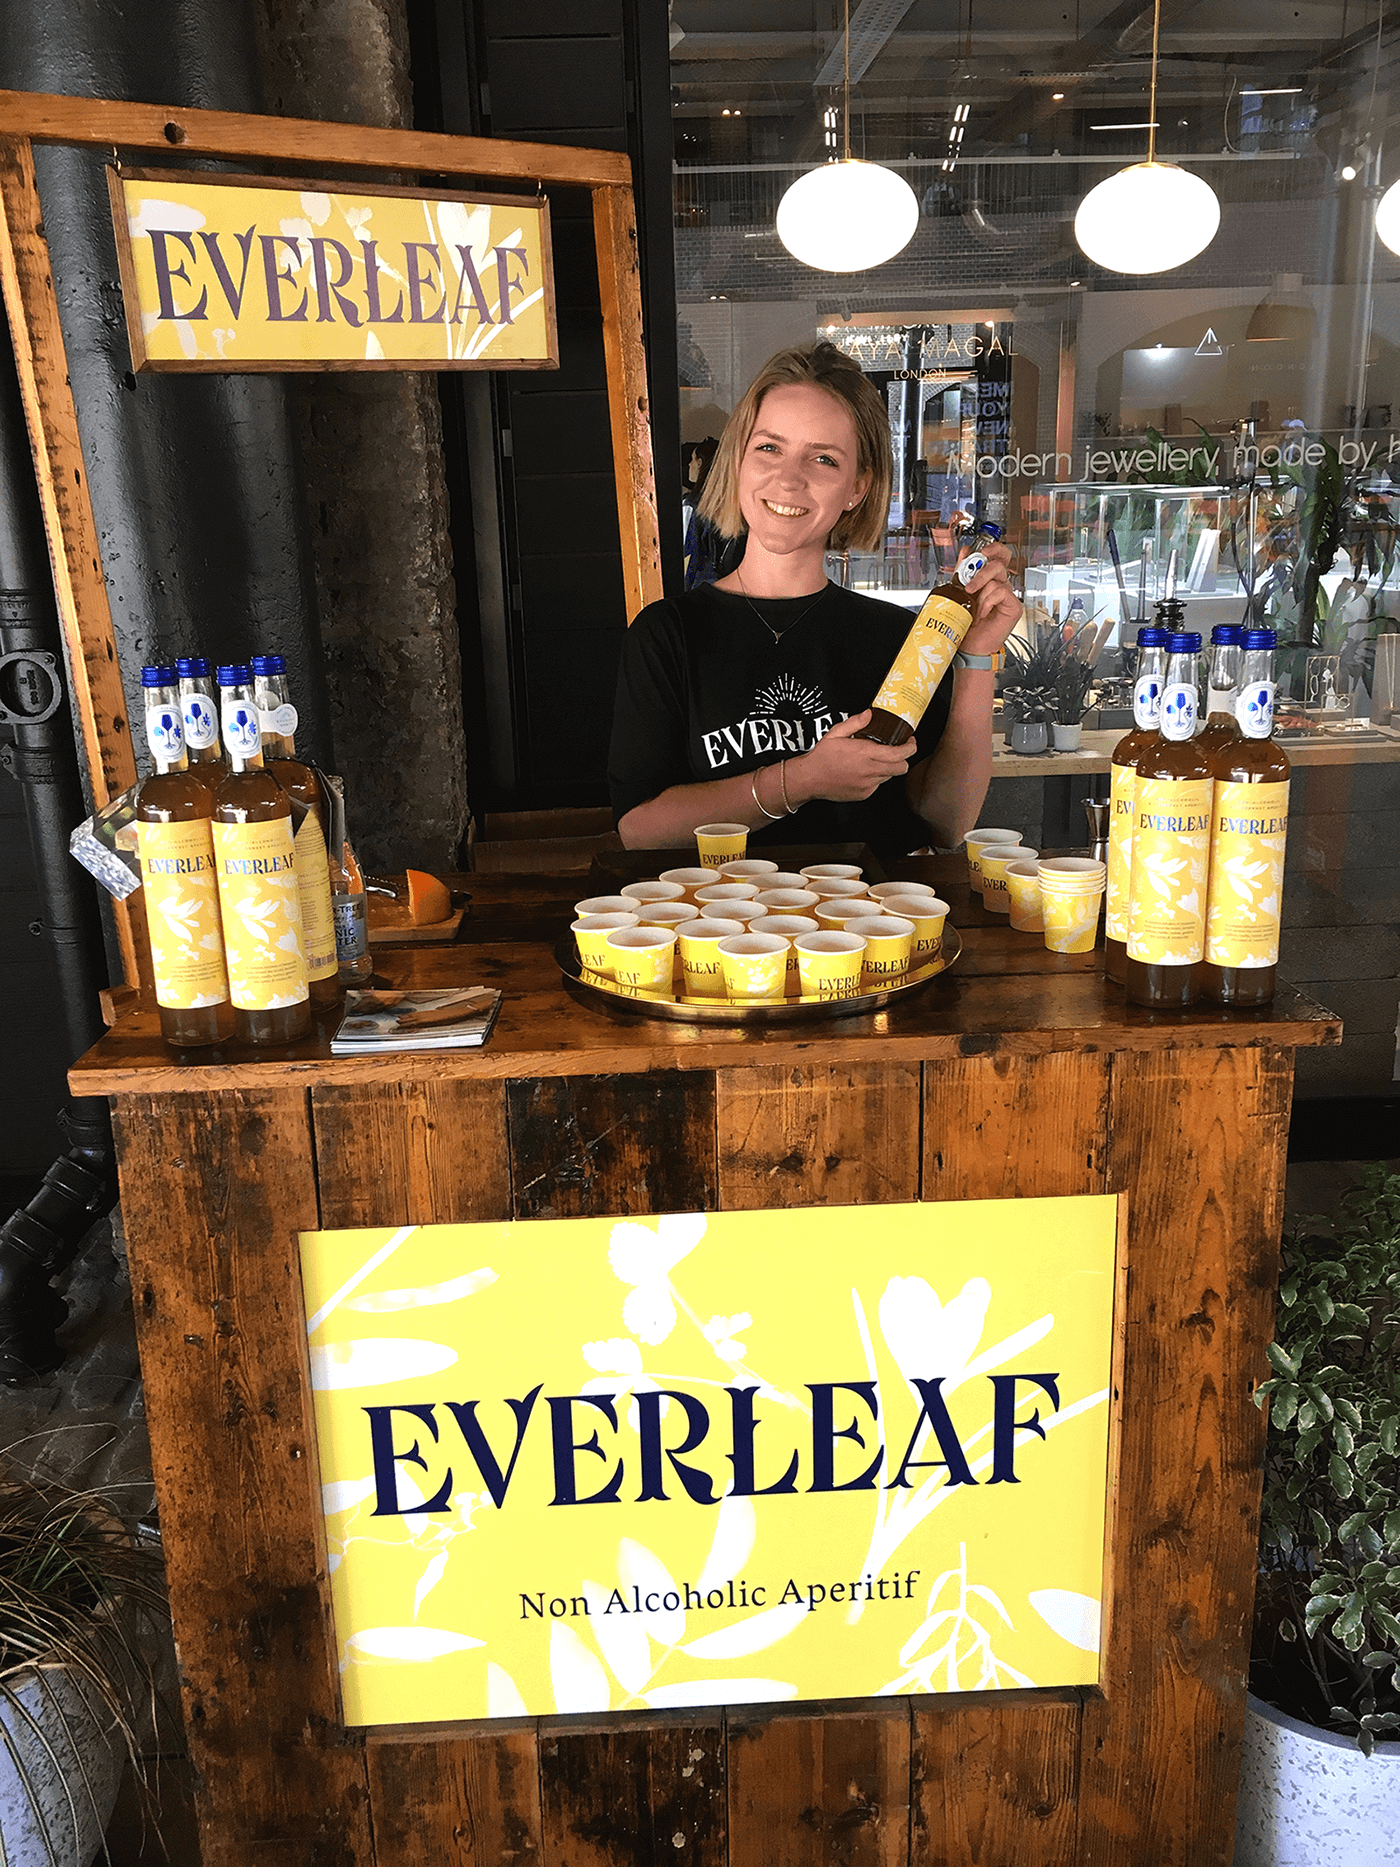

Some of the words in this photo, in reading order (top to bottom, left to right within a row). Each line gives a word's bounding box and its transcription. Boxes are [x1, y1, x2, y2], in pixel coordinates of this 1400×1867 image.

[146, 224, 530, 328] EVERLEAF
[836, 339, 902, 361] AYA
[919, 335, 1019, 359] MAGAL
[893, 368, 947, 381] LONDON
[946, 447, 1072, 479] Modern
[1233, 436, 1327, 469] made
[1338, 435, 1378, 472] by
[1140, 813, 1210, 832] EVERLEAF
[224, 852, 295, 875] EVERLEAF
[361, 1372, 1061, 1517] EVERLEAF
[519, 1591, 592, 1619] Non
[603, 1578, 767, 1616] Alcoholic
[780, 1570, 922, 1612] Aperitif
